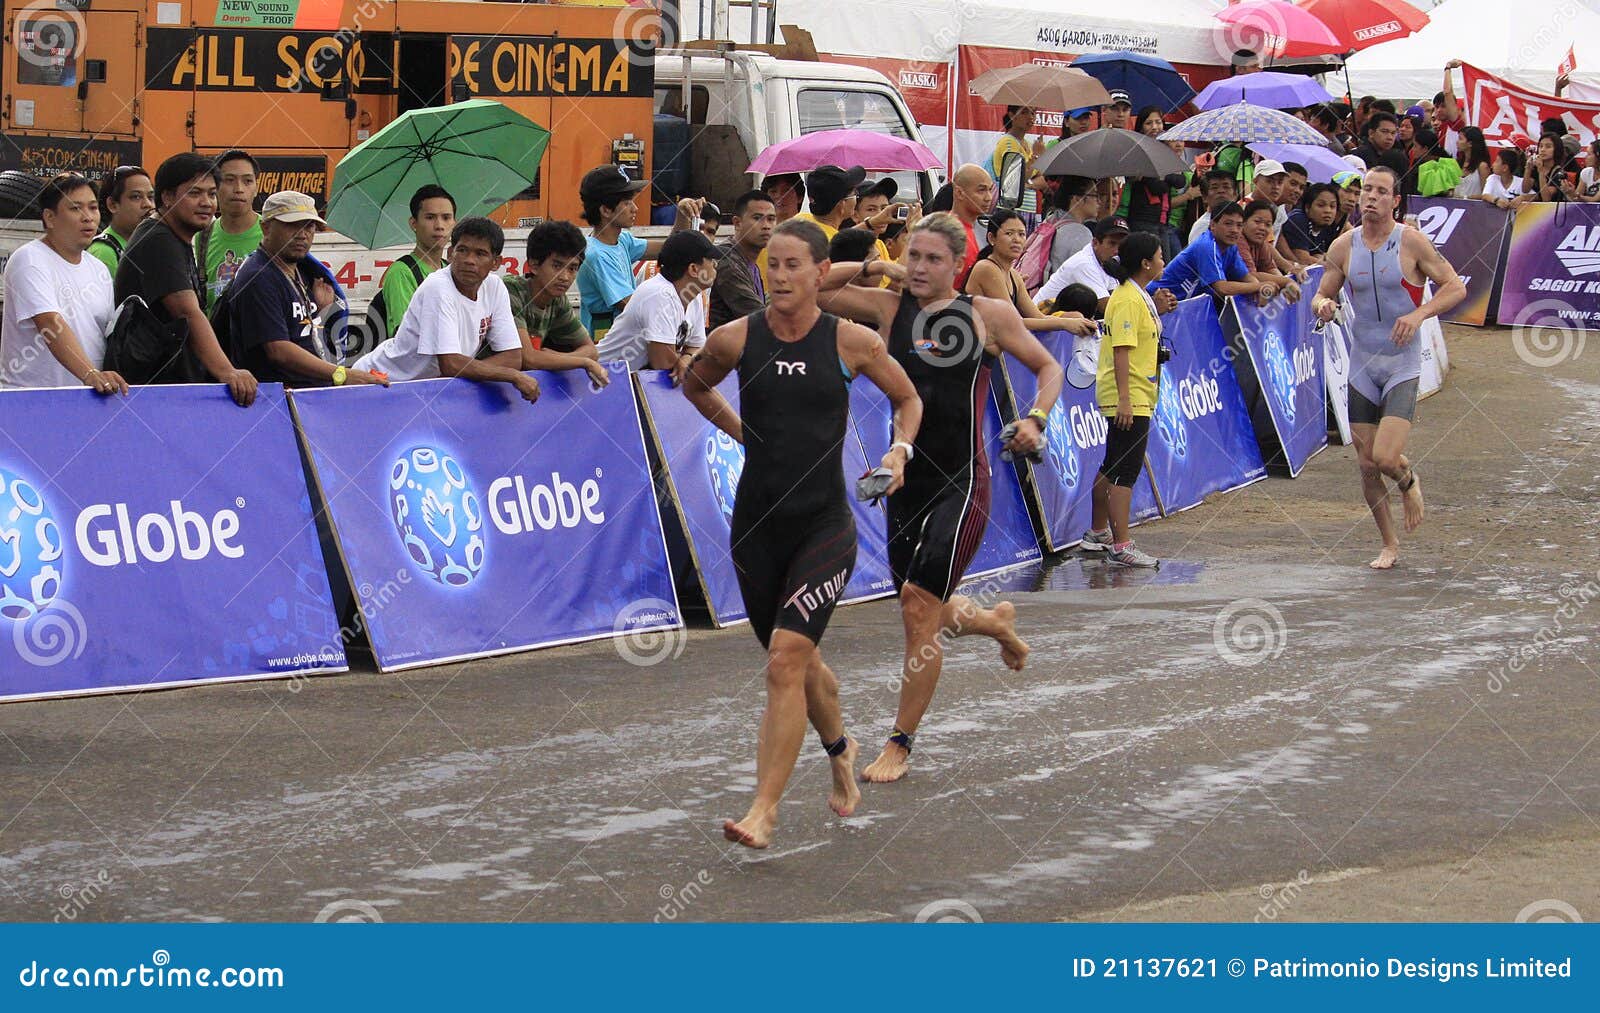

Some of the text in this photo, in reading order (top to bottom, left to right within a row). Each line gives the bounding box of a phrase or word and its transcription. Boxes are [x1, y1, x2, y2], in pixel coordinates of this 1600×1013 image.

[223, 0, 289, 12] NEW SOUND
[262, 15, 294, 25] PROOF
[1037, 27, 1060, 46] ASOG
[1062, 30, 1098, 47] GARDEN
[1357, 21, 1400, 39] ALASKA
[171, 35, 255, 86] ALL
[492, 41, 629, 92] CINEMA
[901, 73, 936, 88] ALASKA
[256, 171, 325, 194] HIGH VOLTAGE
[1528, 278, 1586, 292] SAGOT
[775, 361, 806, 375] TYR
[1179, 374, 1223, 420] Globe
[487, 472, 604, 535] Globe
[75, 500, 245, 566] Globe
[268, 650, 345, 667] www.globe.com.ph
